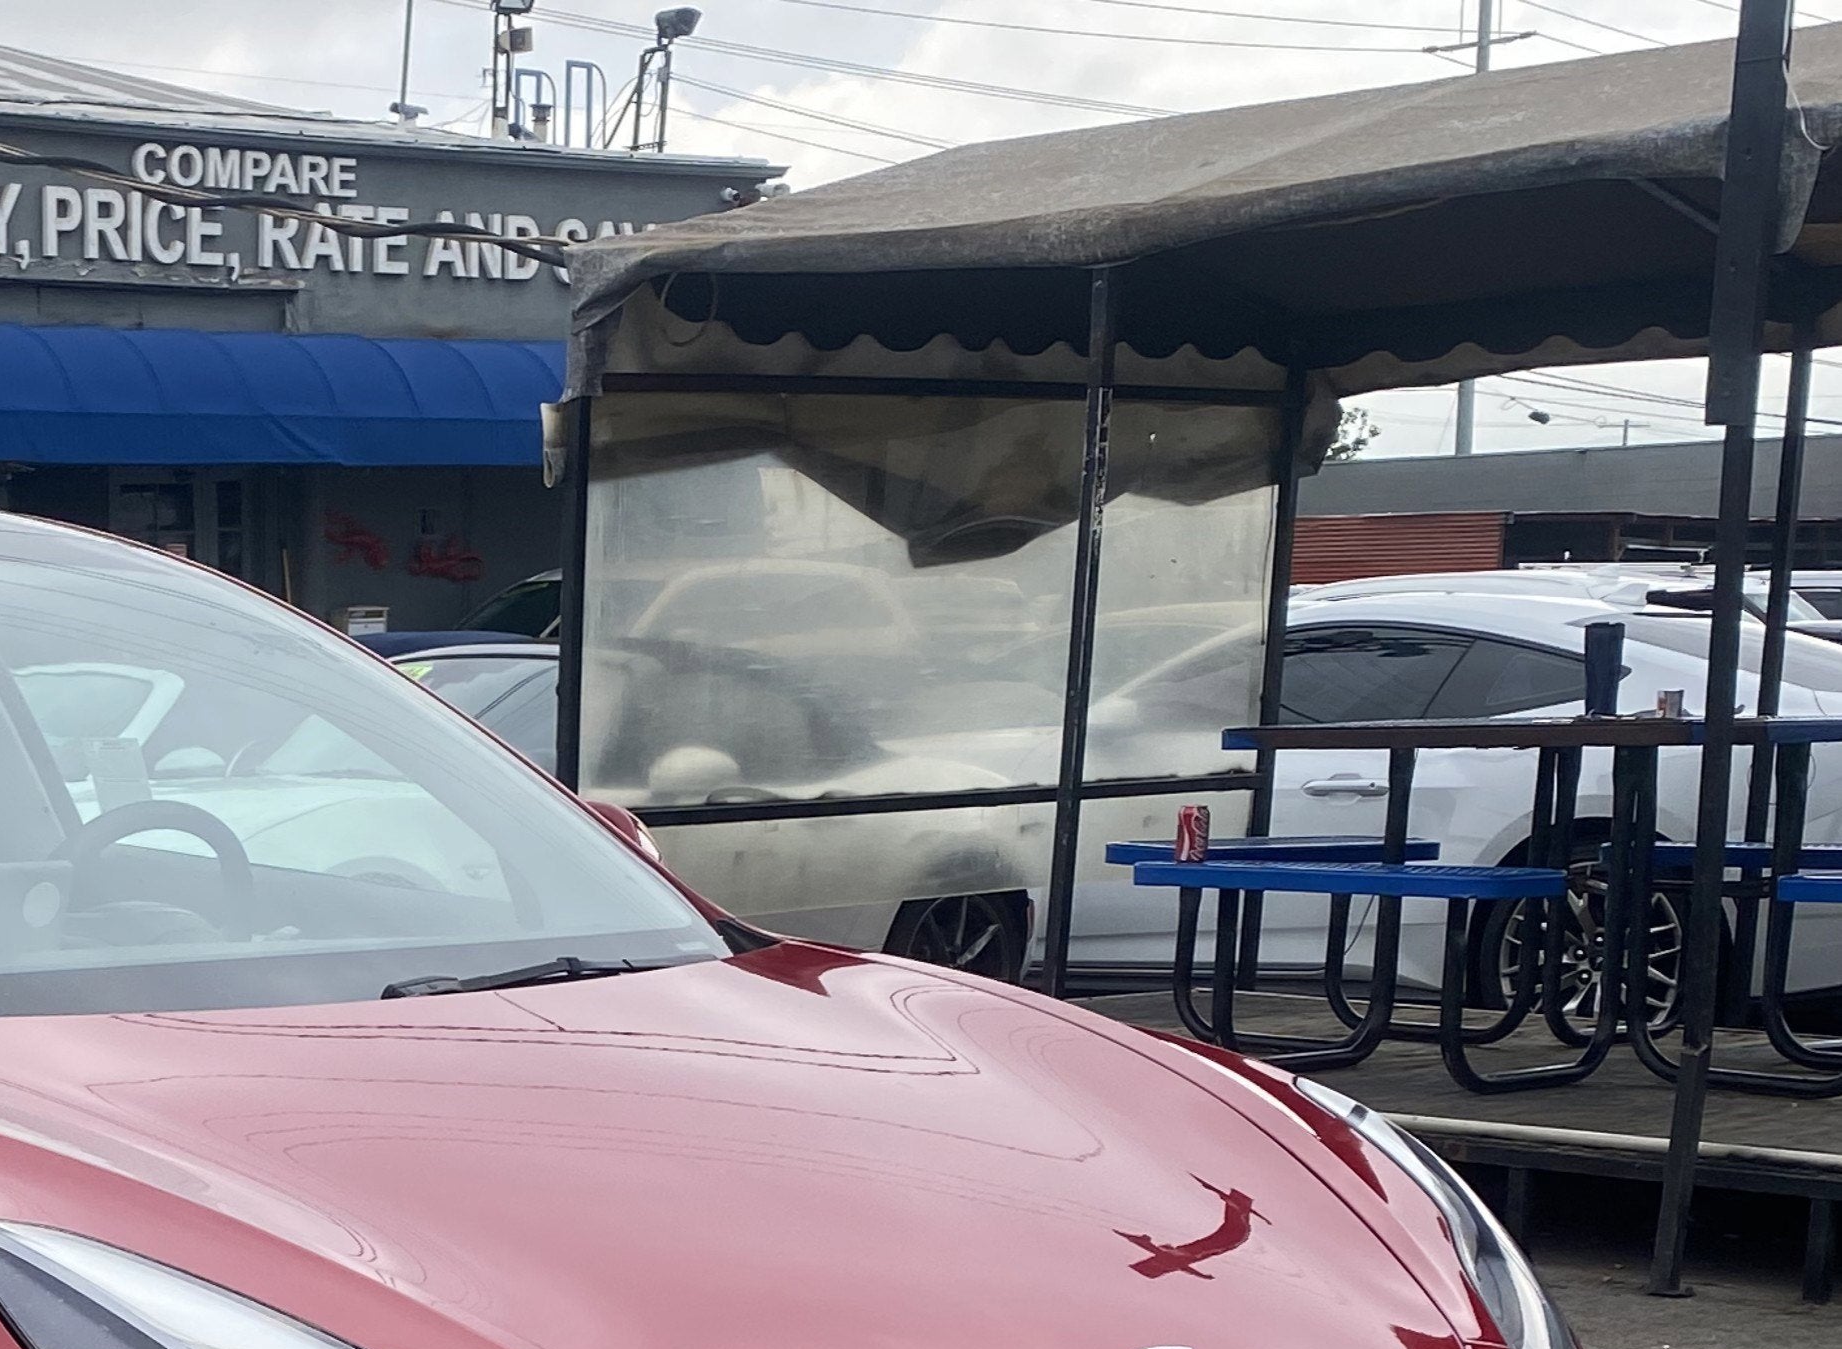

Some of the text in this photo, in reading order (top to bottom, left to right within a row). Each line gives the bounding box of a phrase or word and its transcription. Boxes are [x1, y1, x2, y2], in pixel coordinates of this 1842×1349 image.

[132, 142, 357, 198] COMPARE
[42, 184, 240, 282] PRICE,
[258, 202, 409, 275] RATE
[423, 210, 541, 280] AND
